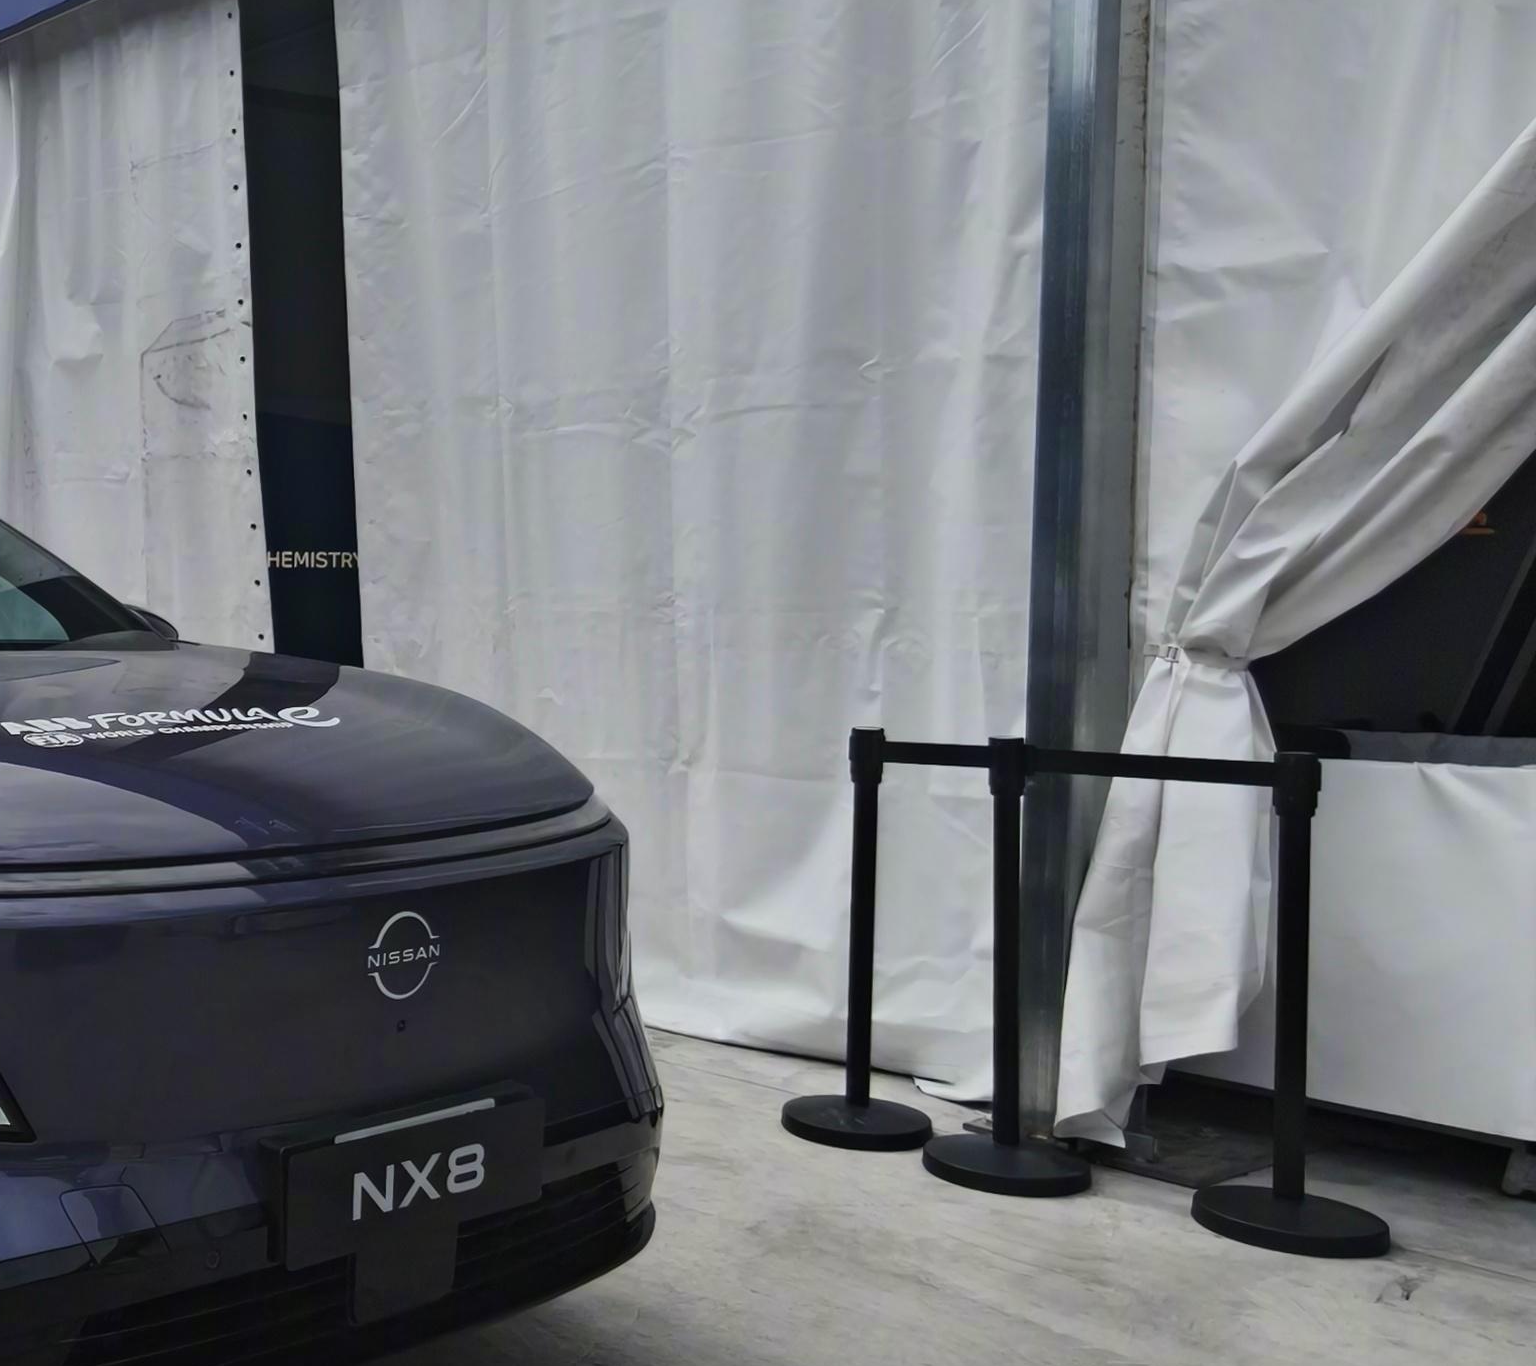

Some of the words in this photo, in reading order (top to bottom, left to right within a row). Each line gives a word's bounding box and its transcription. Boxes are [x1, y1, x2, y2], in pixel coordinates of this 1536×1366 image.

[0, 717, 93, 735] ABB
[88, 707, 281, 731] FORMULA
[83, 728, 154, 740] WORLD
[367, 944, 440, 969] NISSAN
[351, 1142, 486, 1222] NX8
